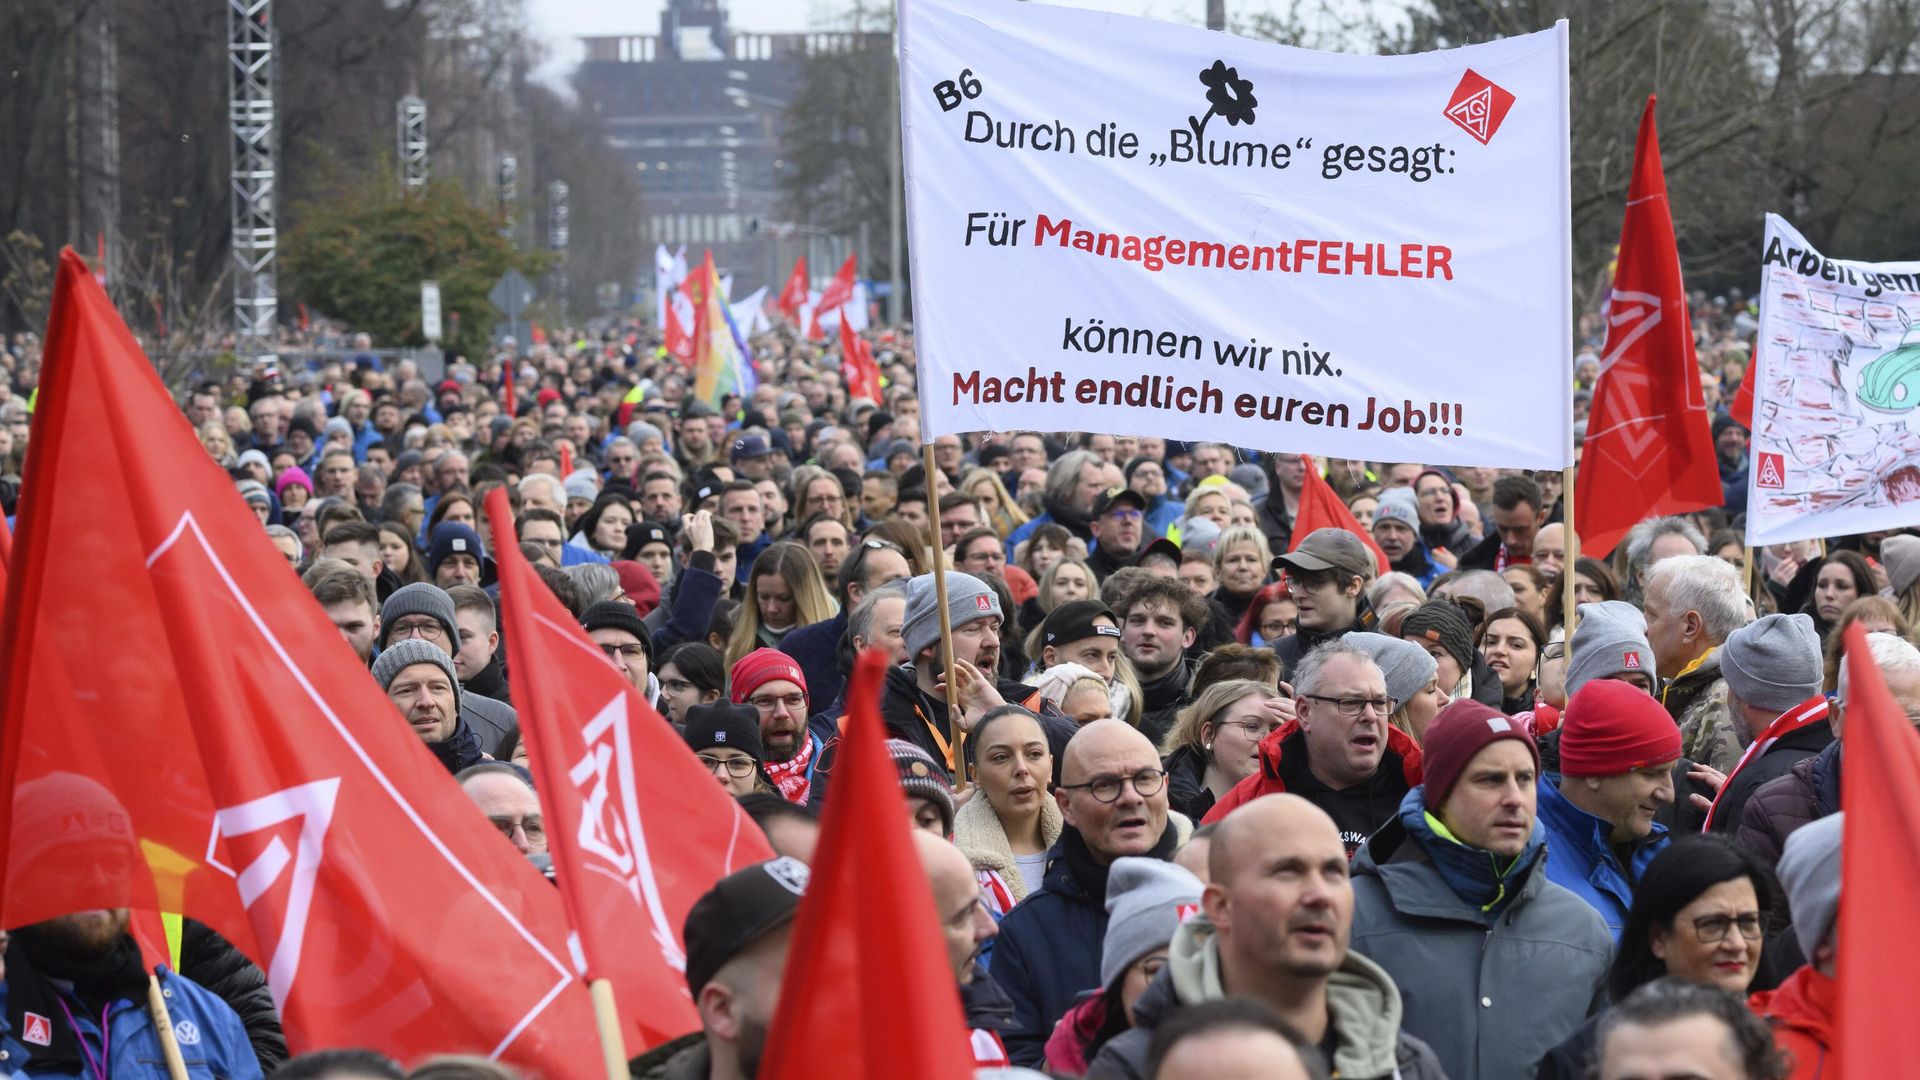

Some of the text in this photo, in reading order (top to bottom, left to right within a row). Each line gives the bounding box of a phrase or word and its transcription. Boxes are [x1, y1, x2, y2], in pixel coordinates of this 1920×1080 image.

[933, 68, 983, 113] B6
[965, 110, 1075, 154] Durch
[1087, 122, 1139, 159] die
[1321, 142, 1456, 183] gesagt:
[964, 212, 1454, 281] Für ManagementFEHLER
[1062, 317, 1343, 378] können wir nix.
[952, 366, 1463, 437] Macht endlich euren Job!!!
